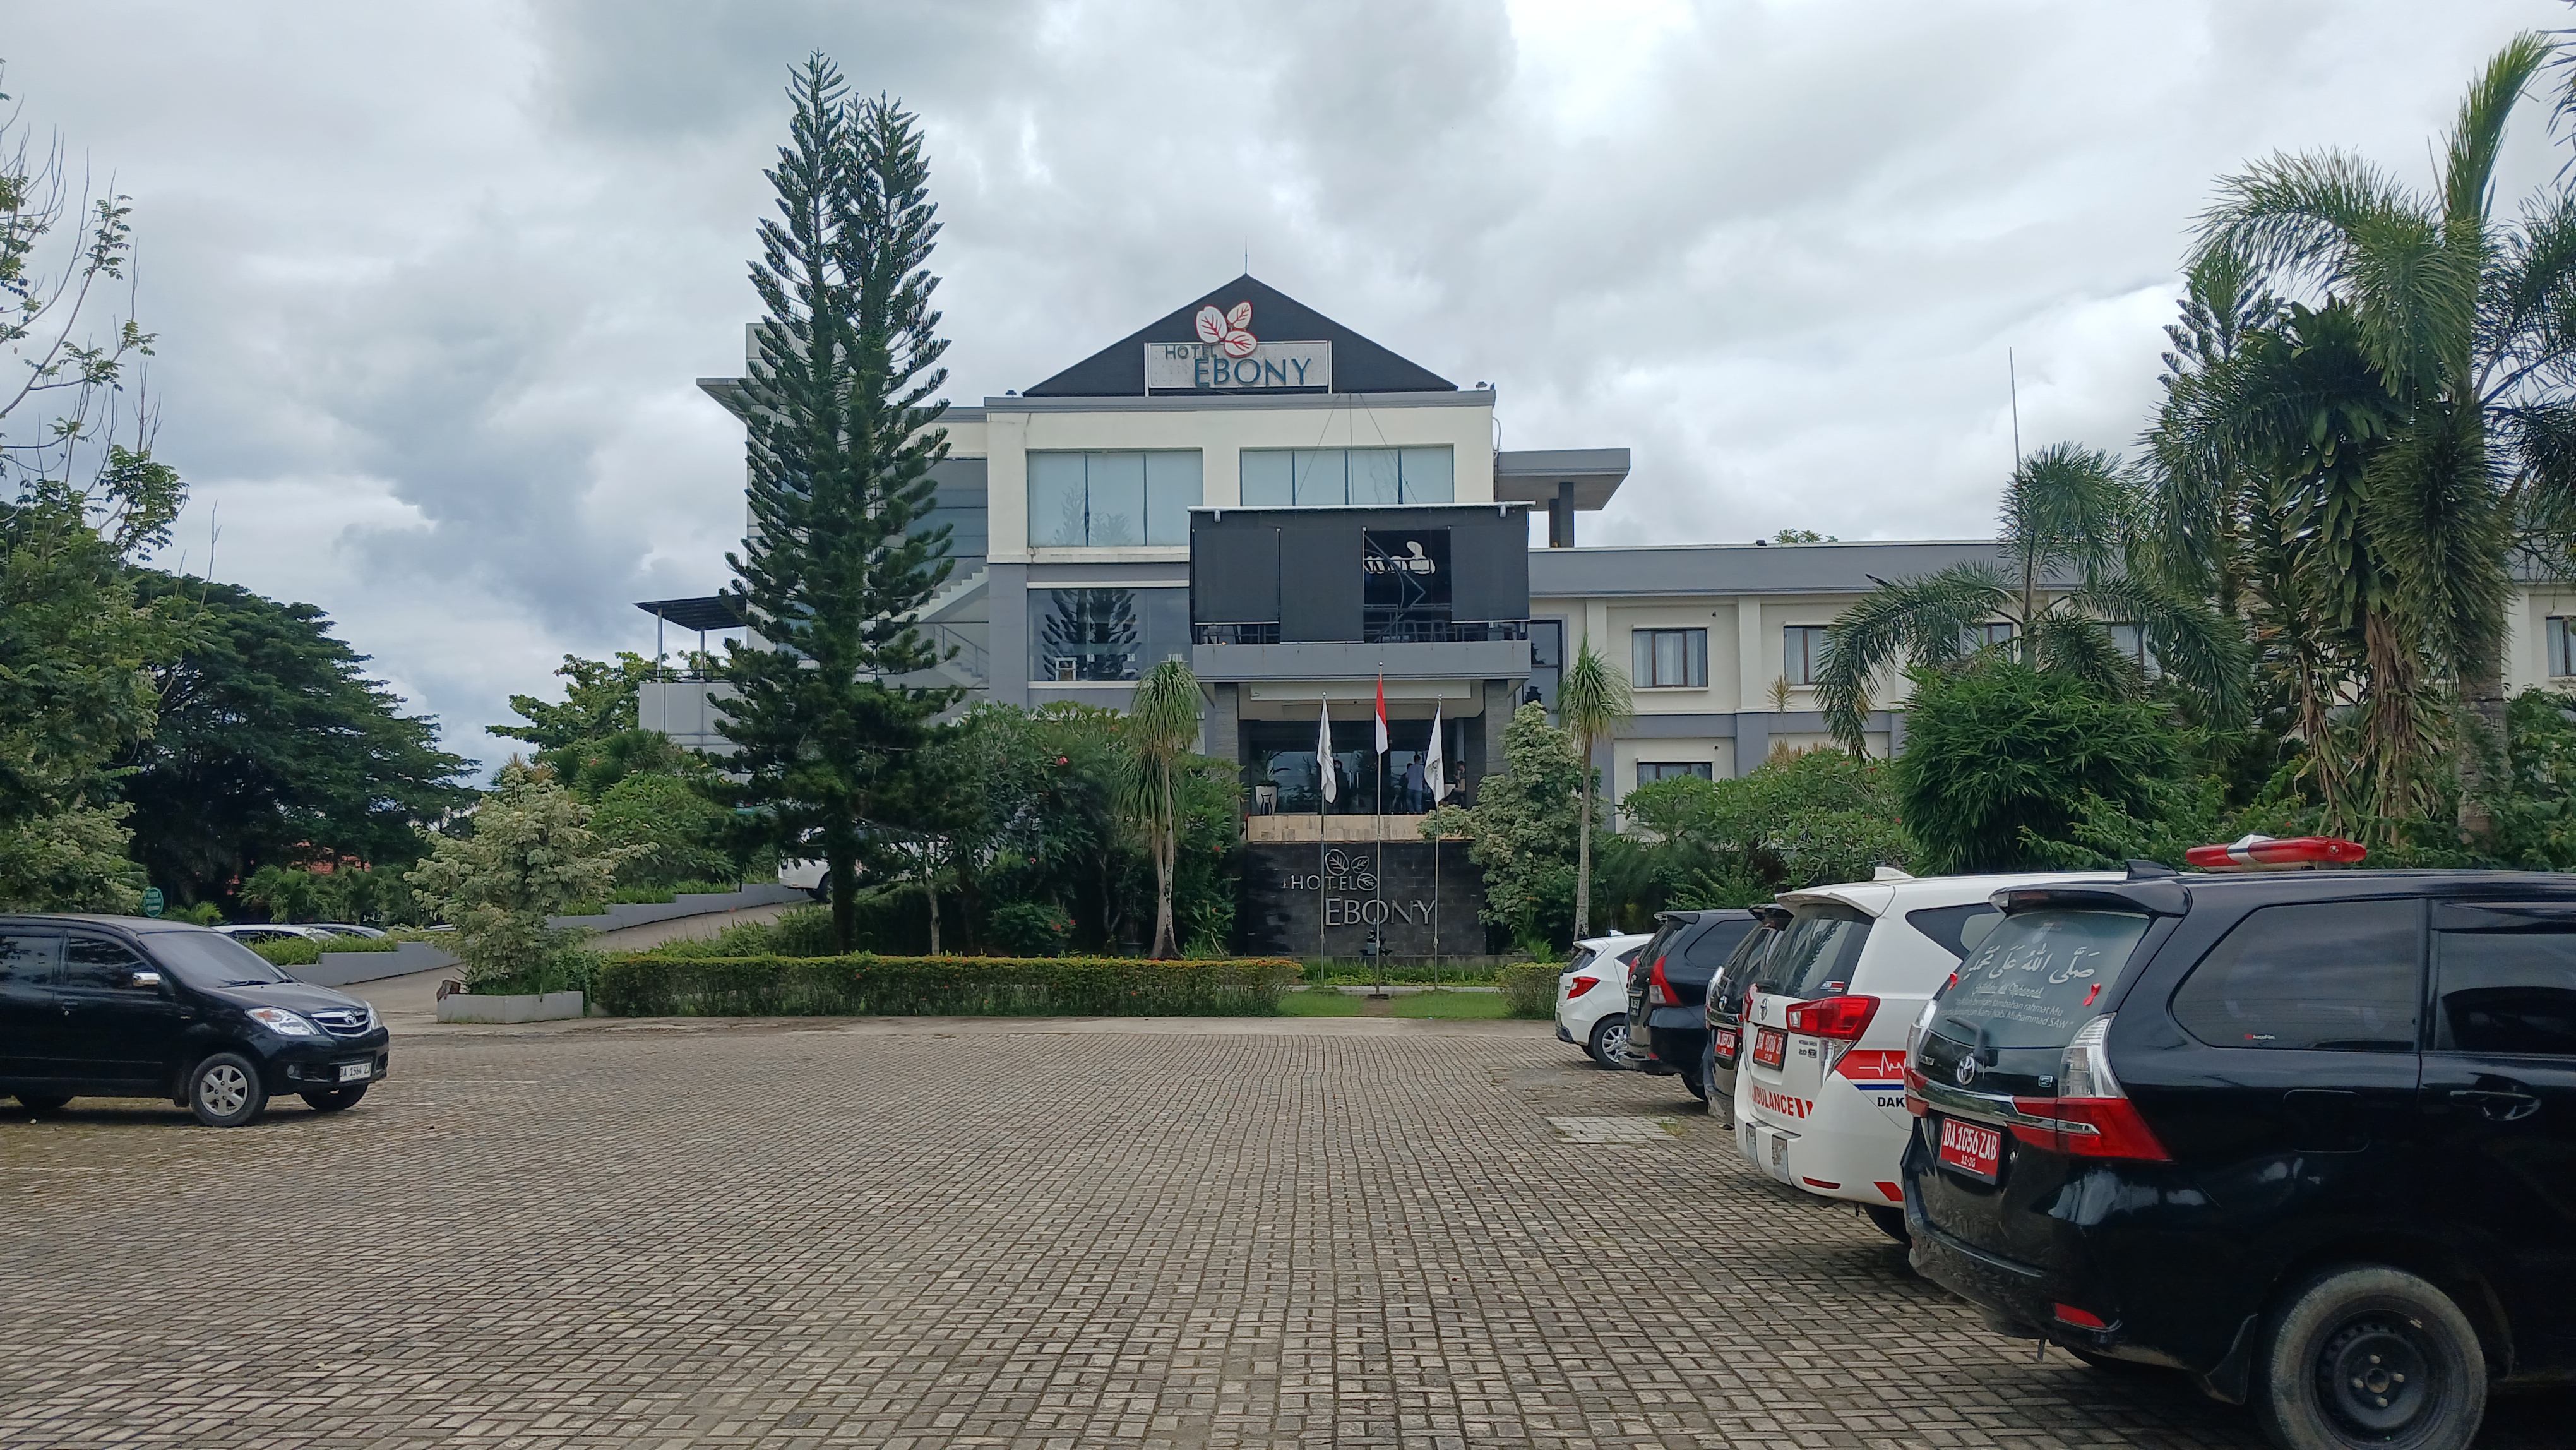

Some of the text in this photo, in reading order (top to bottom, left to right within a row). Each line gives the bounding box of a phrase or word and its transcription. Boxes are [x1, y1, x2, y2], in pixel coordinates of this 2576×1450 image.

[1165, 345, 1217, 360] HOTEL
[1195, 356, 1311, 387] EBONY
[1291, 875, 1357, 891] HOTEL
[1325, 897, 1436, 926] EBONY
[2006, 1010, 2050, 1025] Muhammad
[1752, 1086, 1794, 1117] AMBULANCE
[1876, 1096, 1905, 1108] DAK
[1943, 1122, 1998, 1161] DA 1056 ZAB
